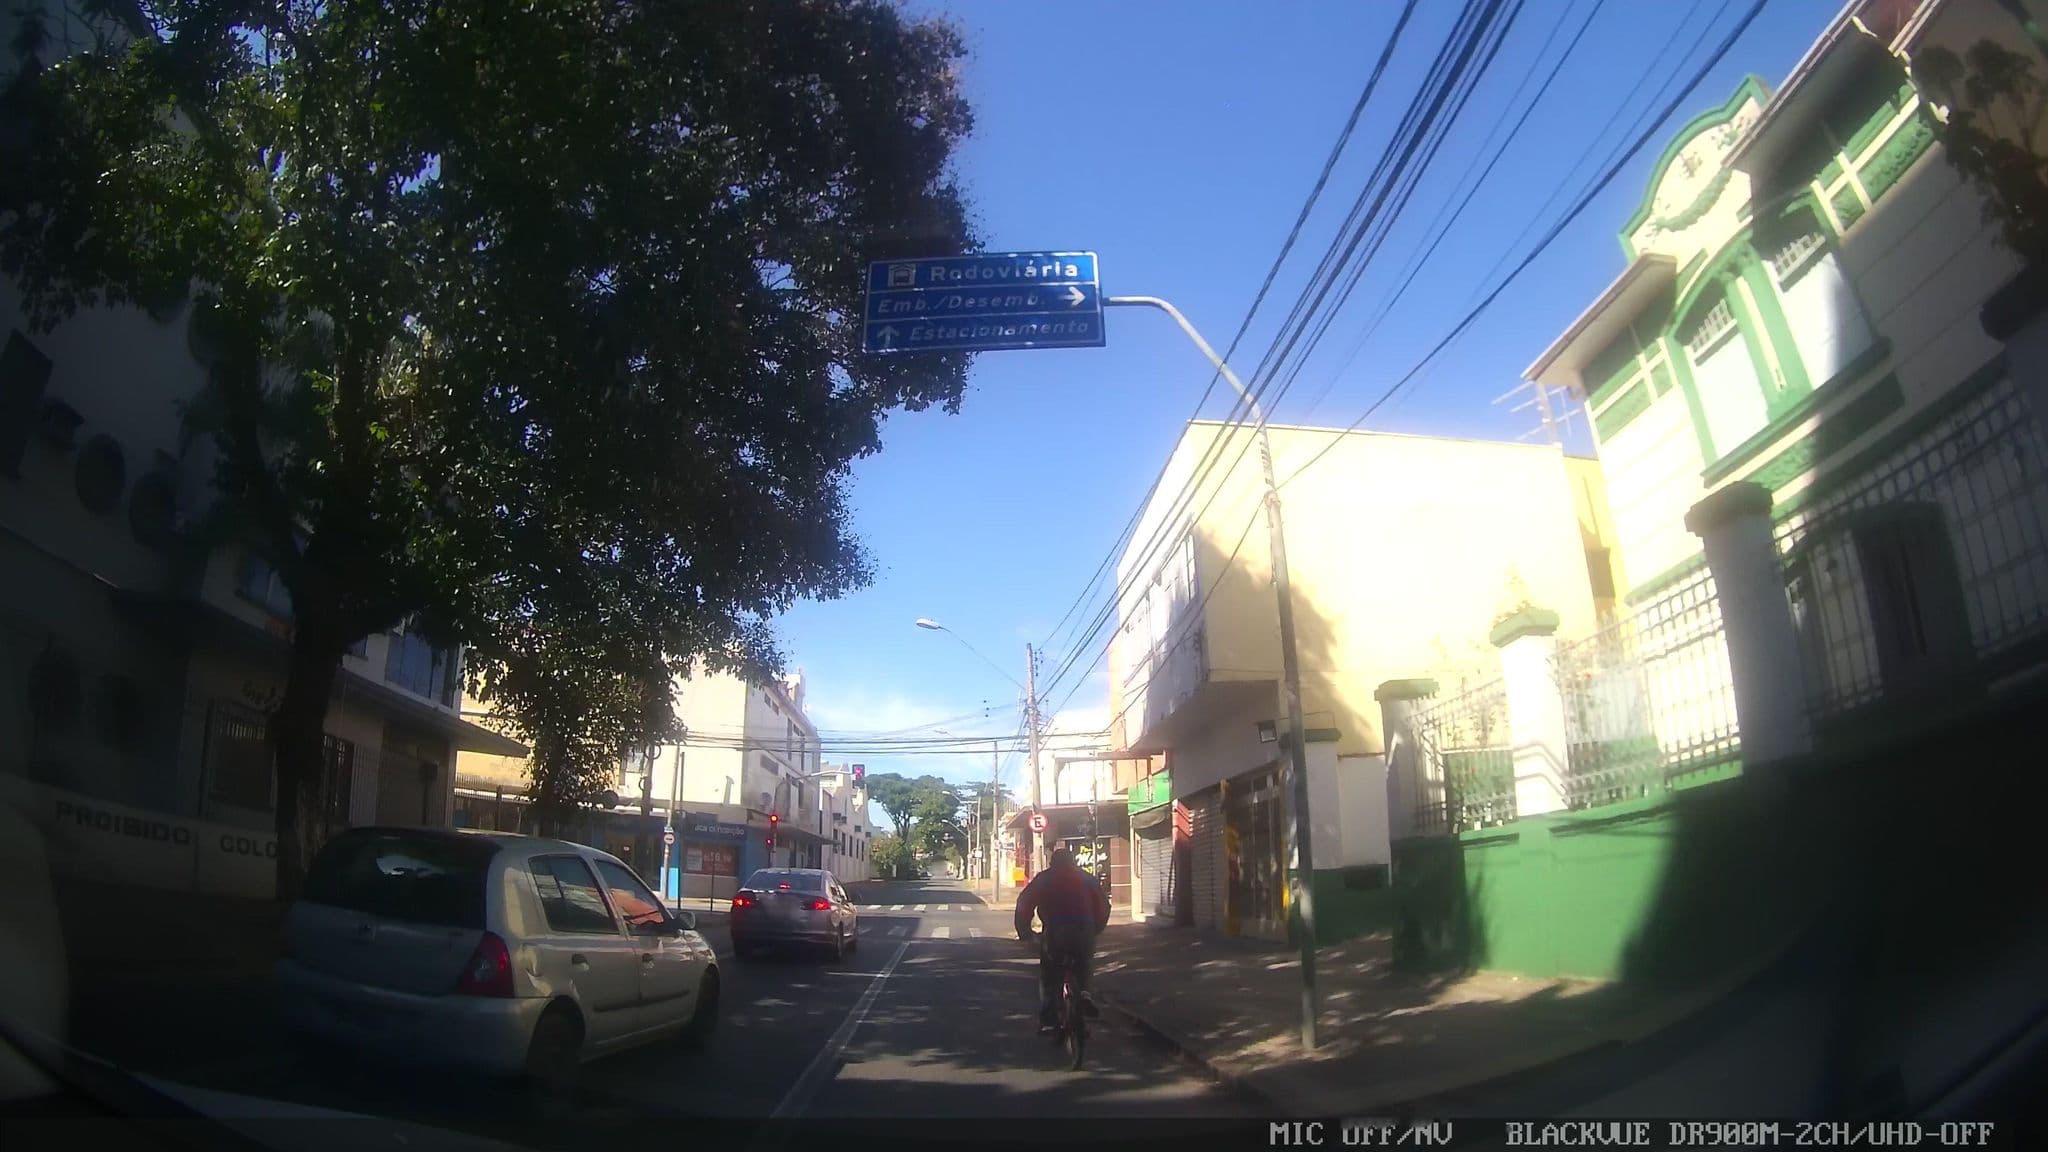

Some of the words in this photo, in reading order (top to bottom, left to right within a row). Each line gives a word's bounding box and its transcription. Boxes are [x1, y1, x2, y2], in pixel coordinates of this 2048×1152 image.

[930, 260, 1080, 282] Rodoviária
[909, 321, 1089, 342] Estacionamento
[55, 800, 191, 845] PROIBIDO
